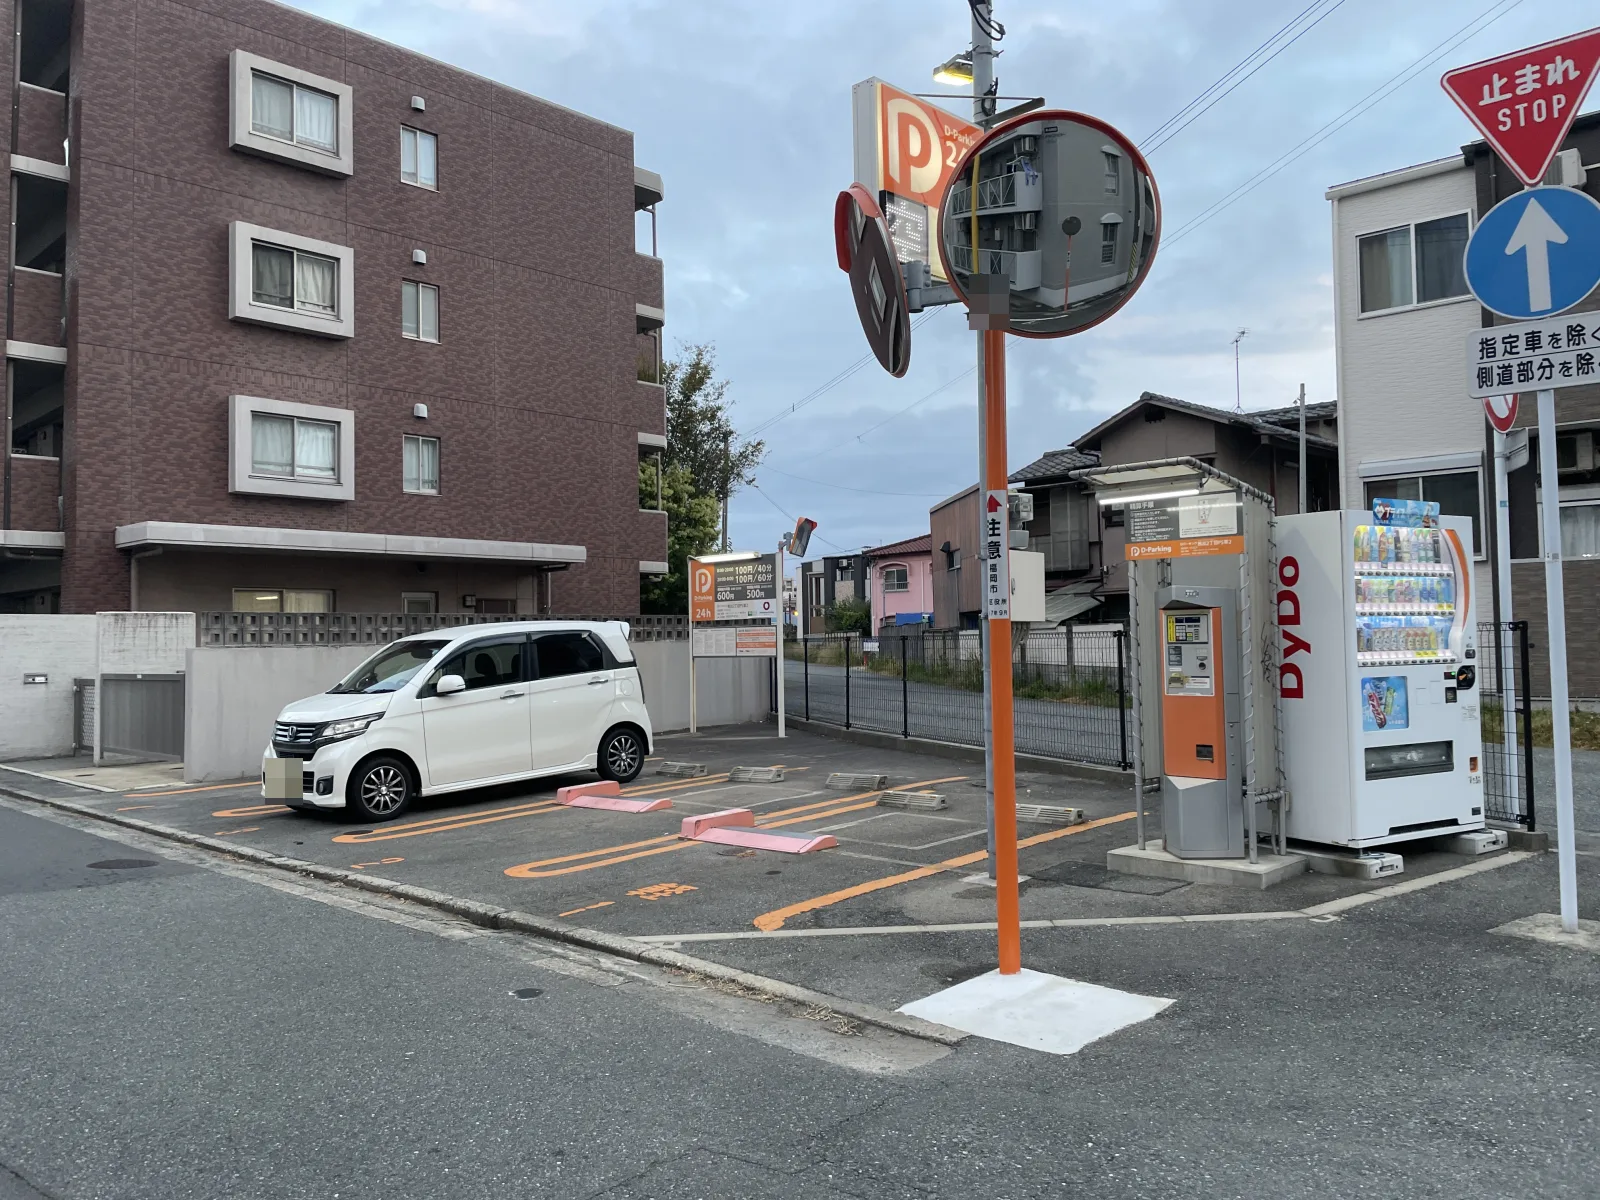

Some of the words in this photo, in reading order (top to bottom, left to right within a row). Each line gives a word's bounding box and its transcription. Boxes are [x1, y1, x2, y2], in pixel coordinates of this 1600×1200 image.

[1478, 55, 1580, 106] 止まれ
[1497, 93, 1567, 131] STOP
[1478, 323, 1600, 360] 指定車を除く
[1476, 352, 1600, 389] 側道部分を除
[987, 518, 1001, 560] 注意
[717, 591, 734, 600] 600円
[746, 589, 765, 599] 500円
[696, 608, 711, 619] 24h
